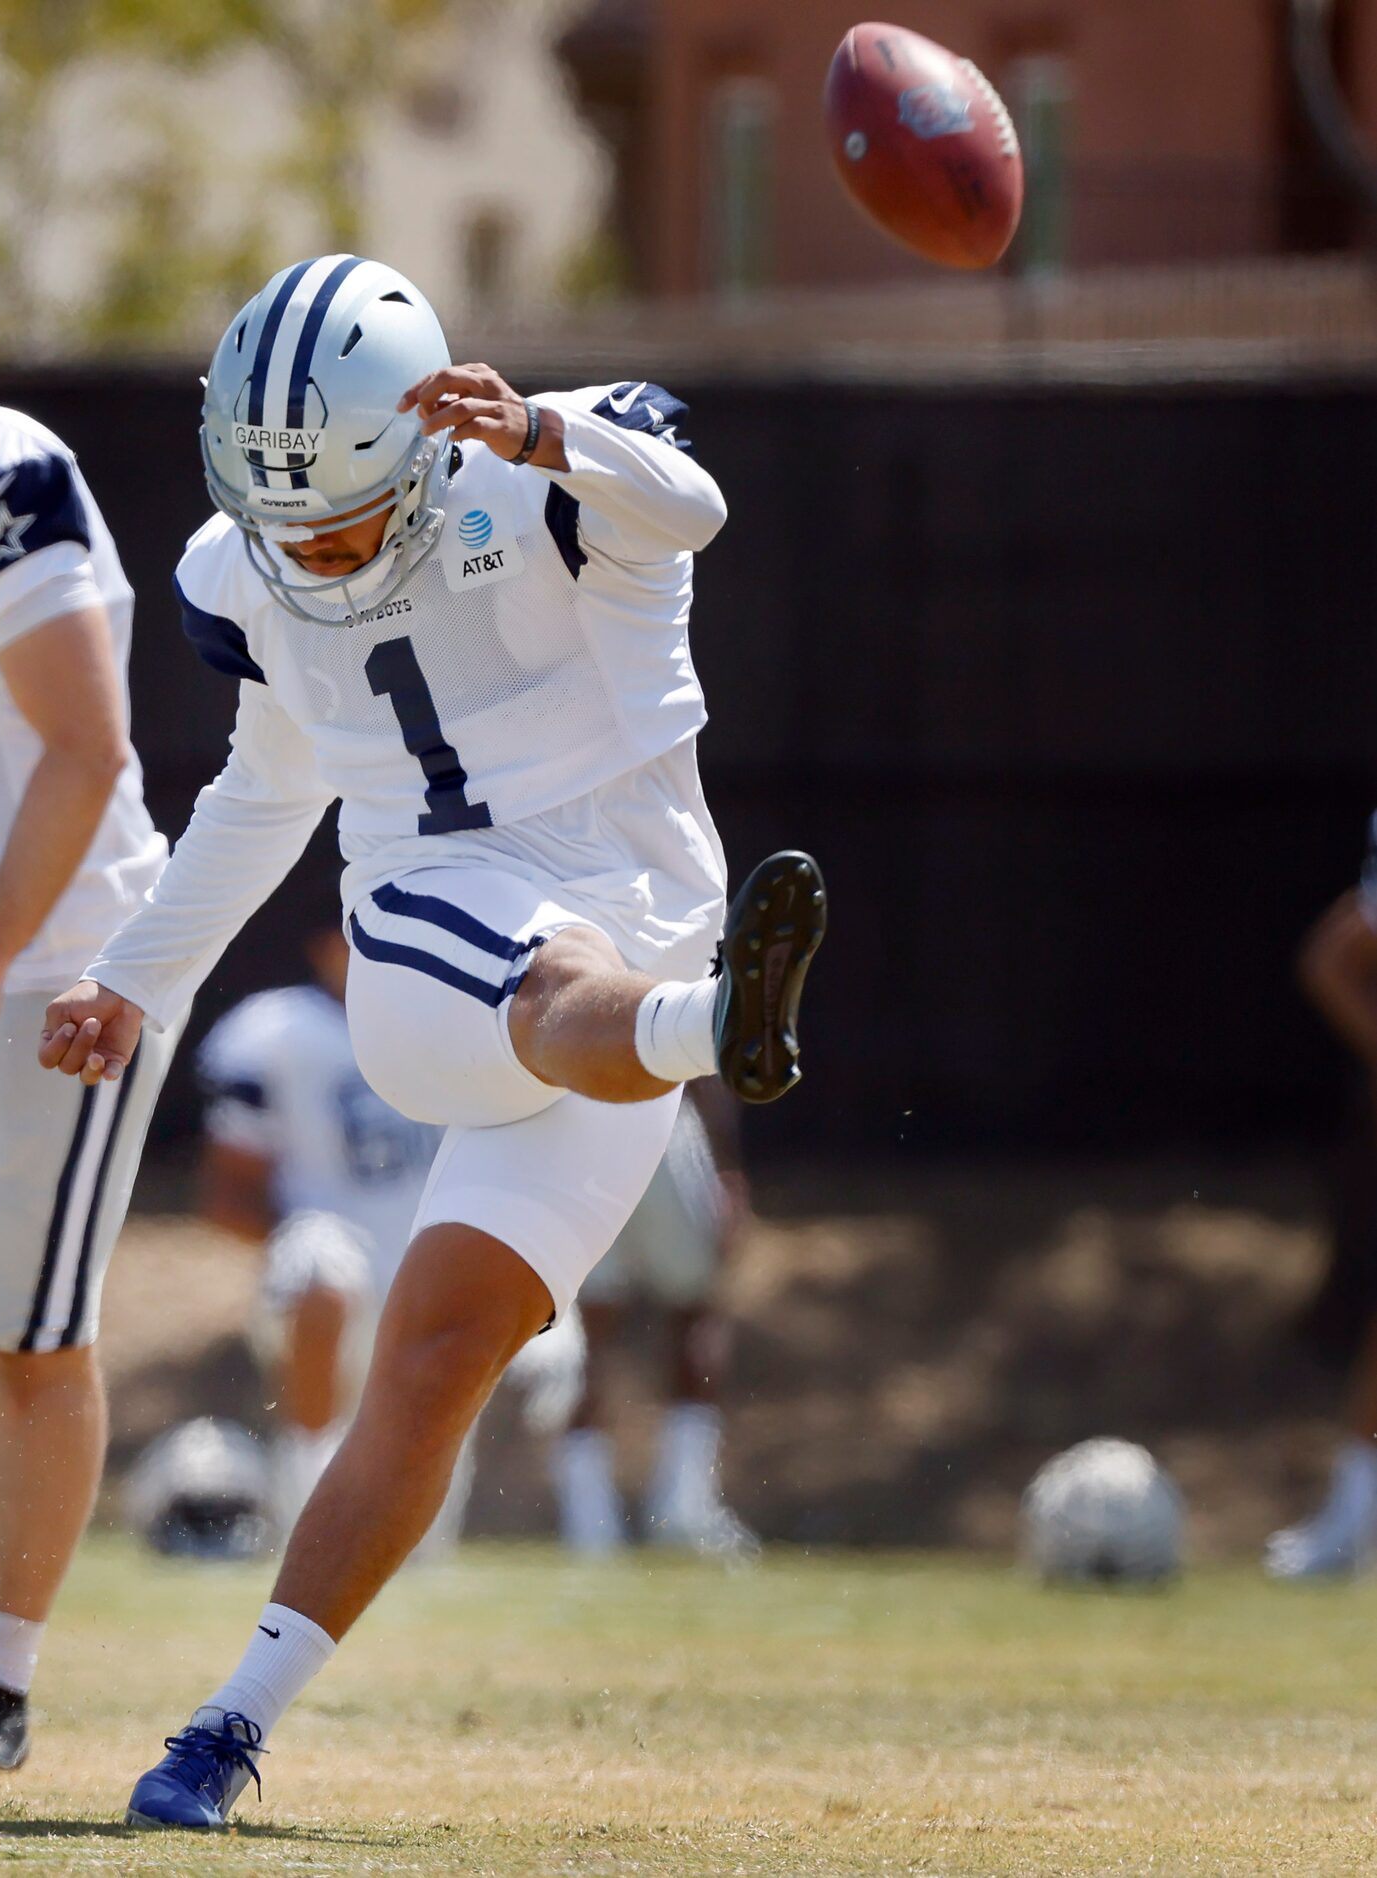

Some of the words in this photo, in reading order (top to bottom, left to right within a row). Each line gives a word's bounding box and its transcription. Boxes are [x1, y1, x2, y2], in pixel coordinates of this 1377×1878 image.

[235, 426, 320, 450] GARIBAY
[462, 550, 504, 578] AT&T
[344, 599, 412, 628] CBOYS
[364, 635, 493, 836] 1
